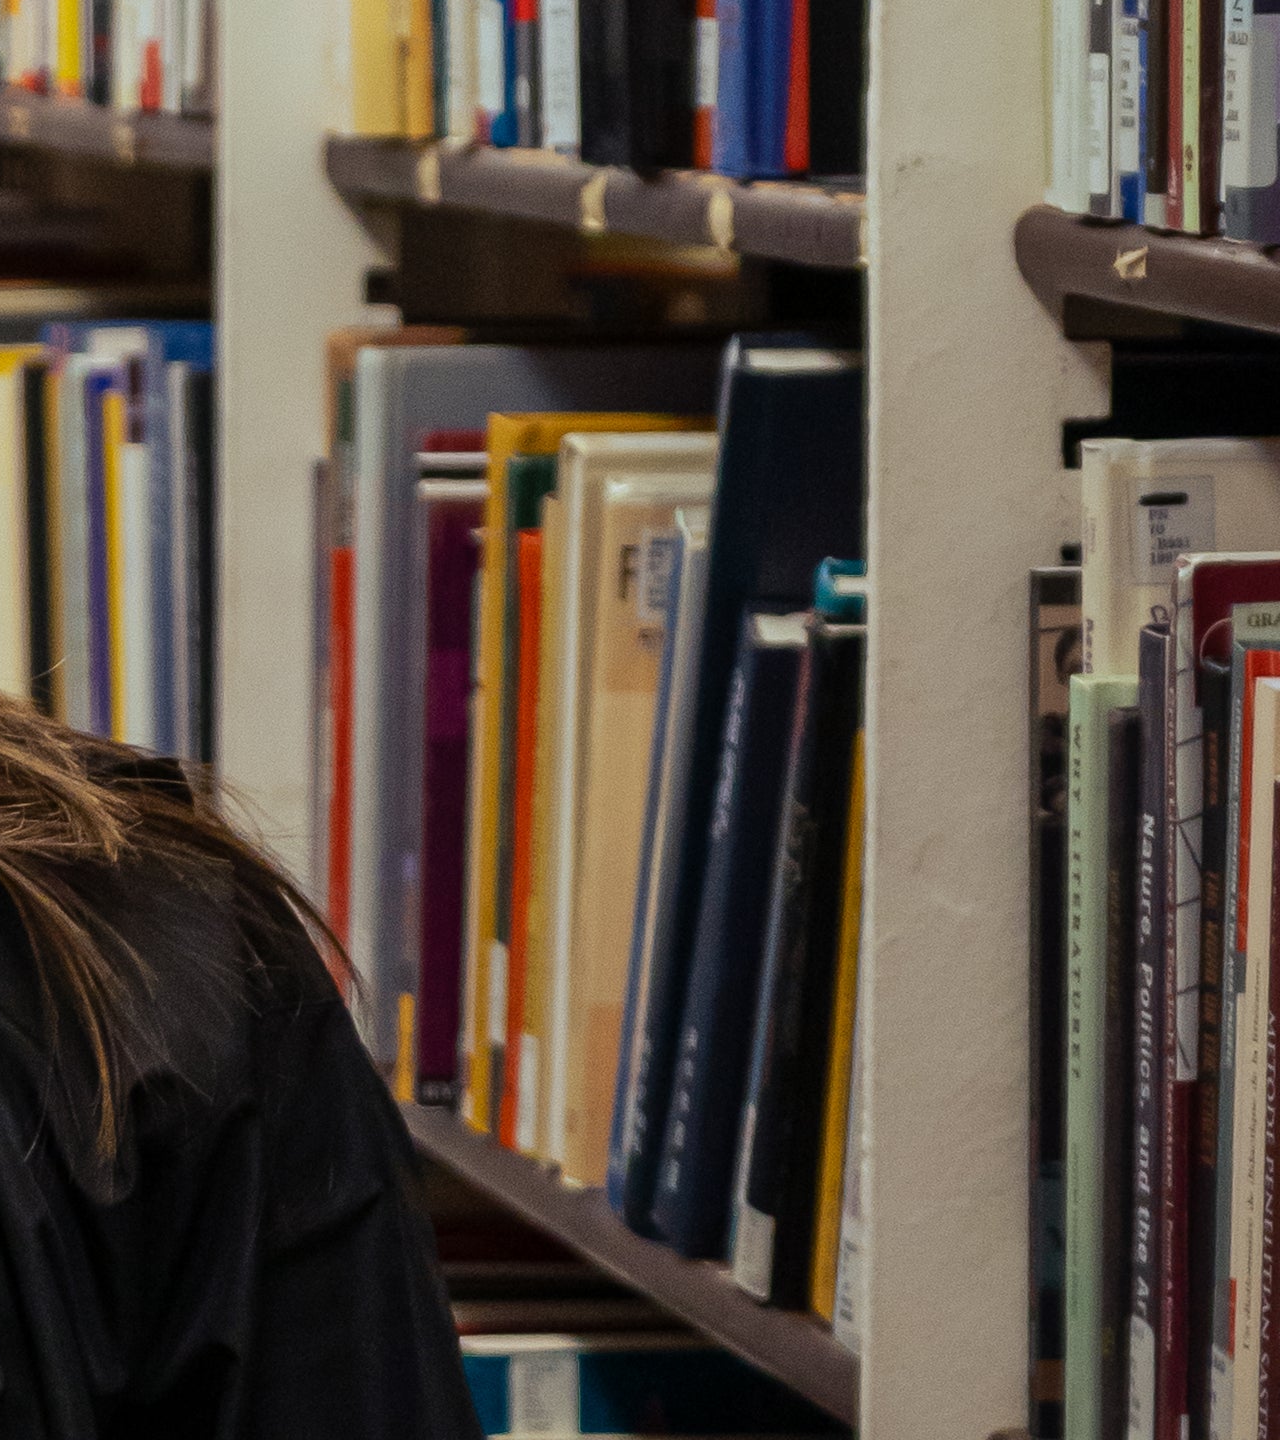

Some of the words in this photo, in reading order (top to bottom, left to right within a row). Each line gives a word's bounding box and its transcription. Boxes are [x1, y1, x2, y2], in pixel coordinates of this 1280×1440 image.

[1072, 723, 1082, 804] WHY
[1071, 829, 1082, 1079] LITERATURE?
[1266, 1009, 1276, 1143] METODE
[1138, 1124, 1152, 1194] and
[1137, 1206, 1151, 1263] the
[1261, 1156, 1274, 1338] PENELITIAN
